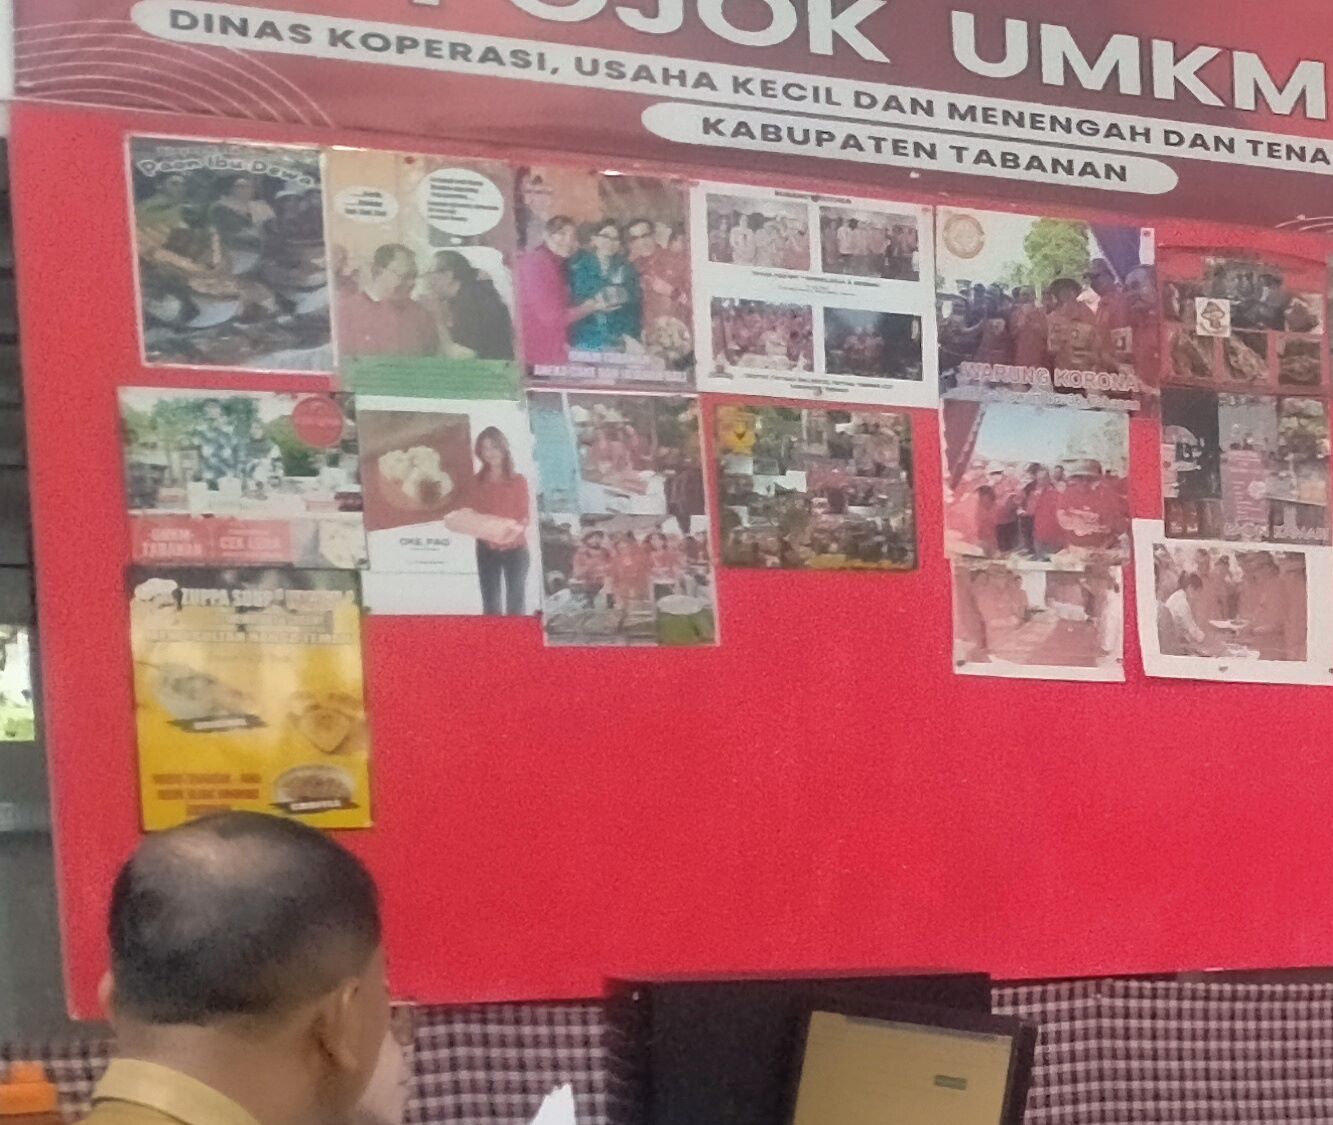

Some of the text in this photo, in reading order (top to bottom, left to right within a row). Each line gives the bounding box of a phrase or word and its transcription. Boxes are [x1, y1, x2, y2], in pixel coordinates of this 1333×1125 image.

[169, 8, 312, 43] DINAS
[327, 27, 560, 75] KOPERASI,
[574, 56, 718, 92] USAHA
[731, 75, 842, 107] KECIL
[853, 90, 935, 118] DAN
[947, 101, 1152, 144] MENENGAH
[1163, 128, 1236, 154] DAN
[413, 0, 1327, 121] JOK UMKM
[702, 116, 1128, 182] KABUPATEN TABANAN
